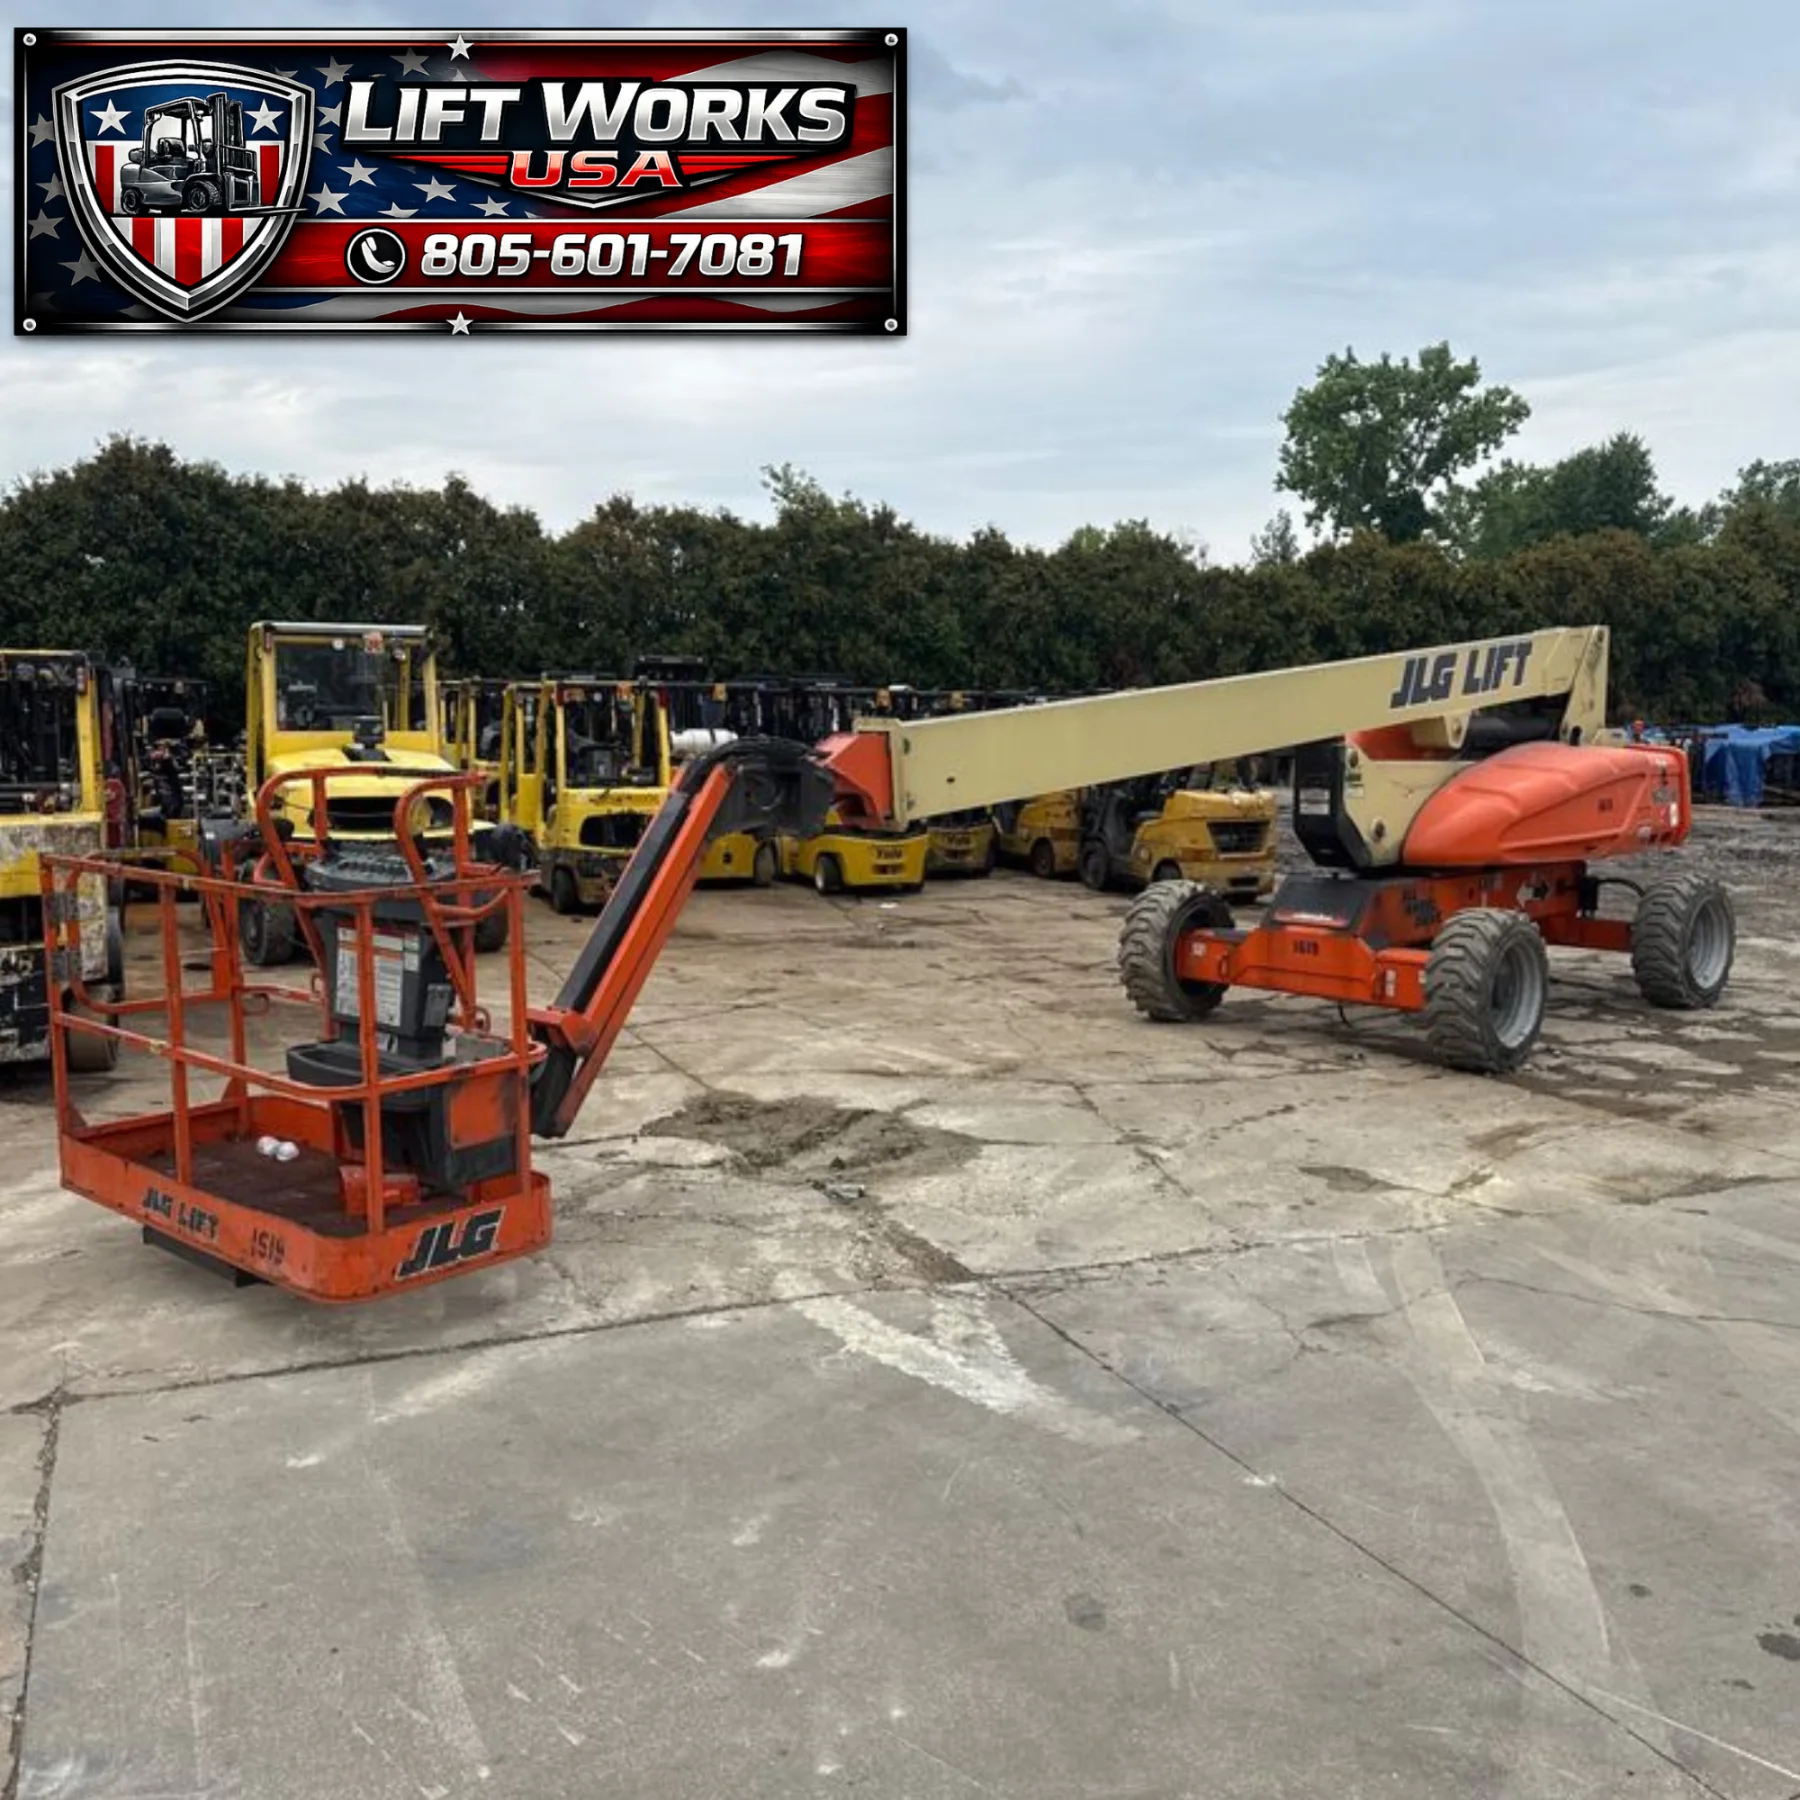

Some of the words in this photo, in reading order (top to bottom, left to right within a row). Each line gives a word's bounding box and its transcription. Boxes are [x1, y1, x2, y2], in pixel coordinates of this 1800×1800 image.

[1391, 652, 1457, 708] JLG
[1463, 641, 1533, 695] LIFT
[178, 1202, 219, 1239] LIFT
[397, 1208, 504, 1278] JLG
